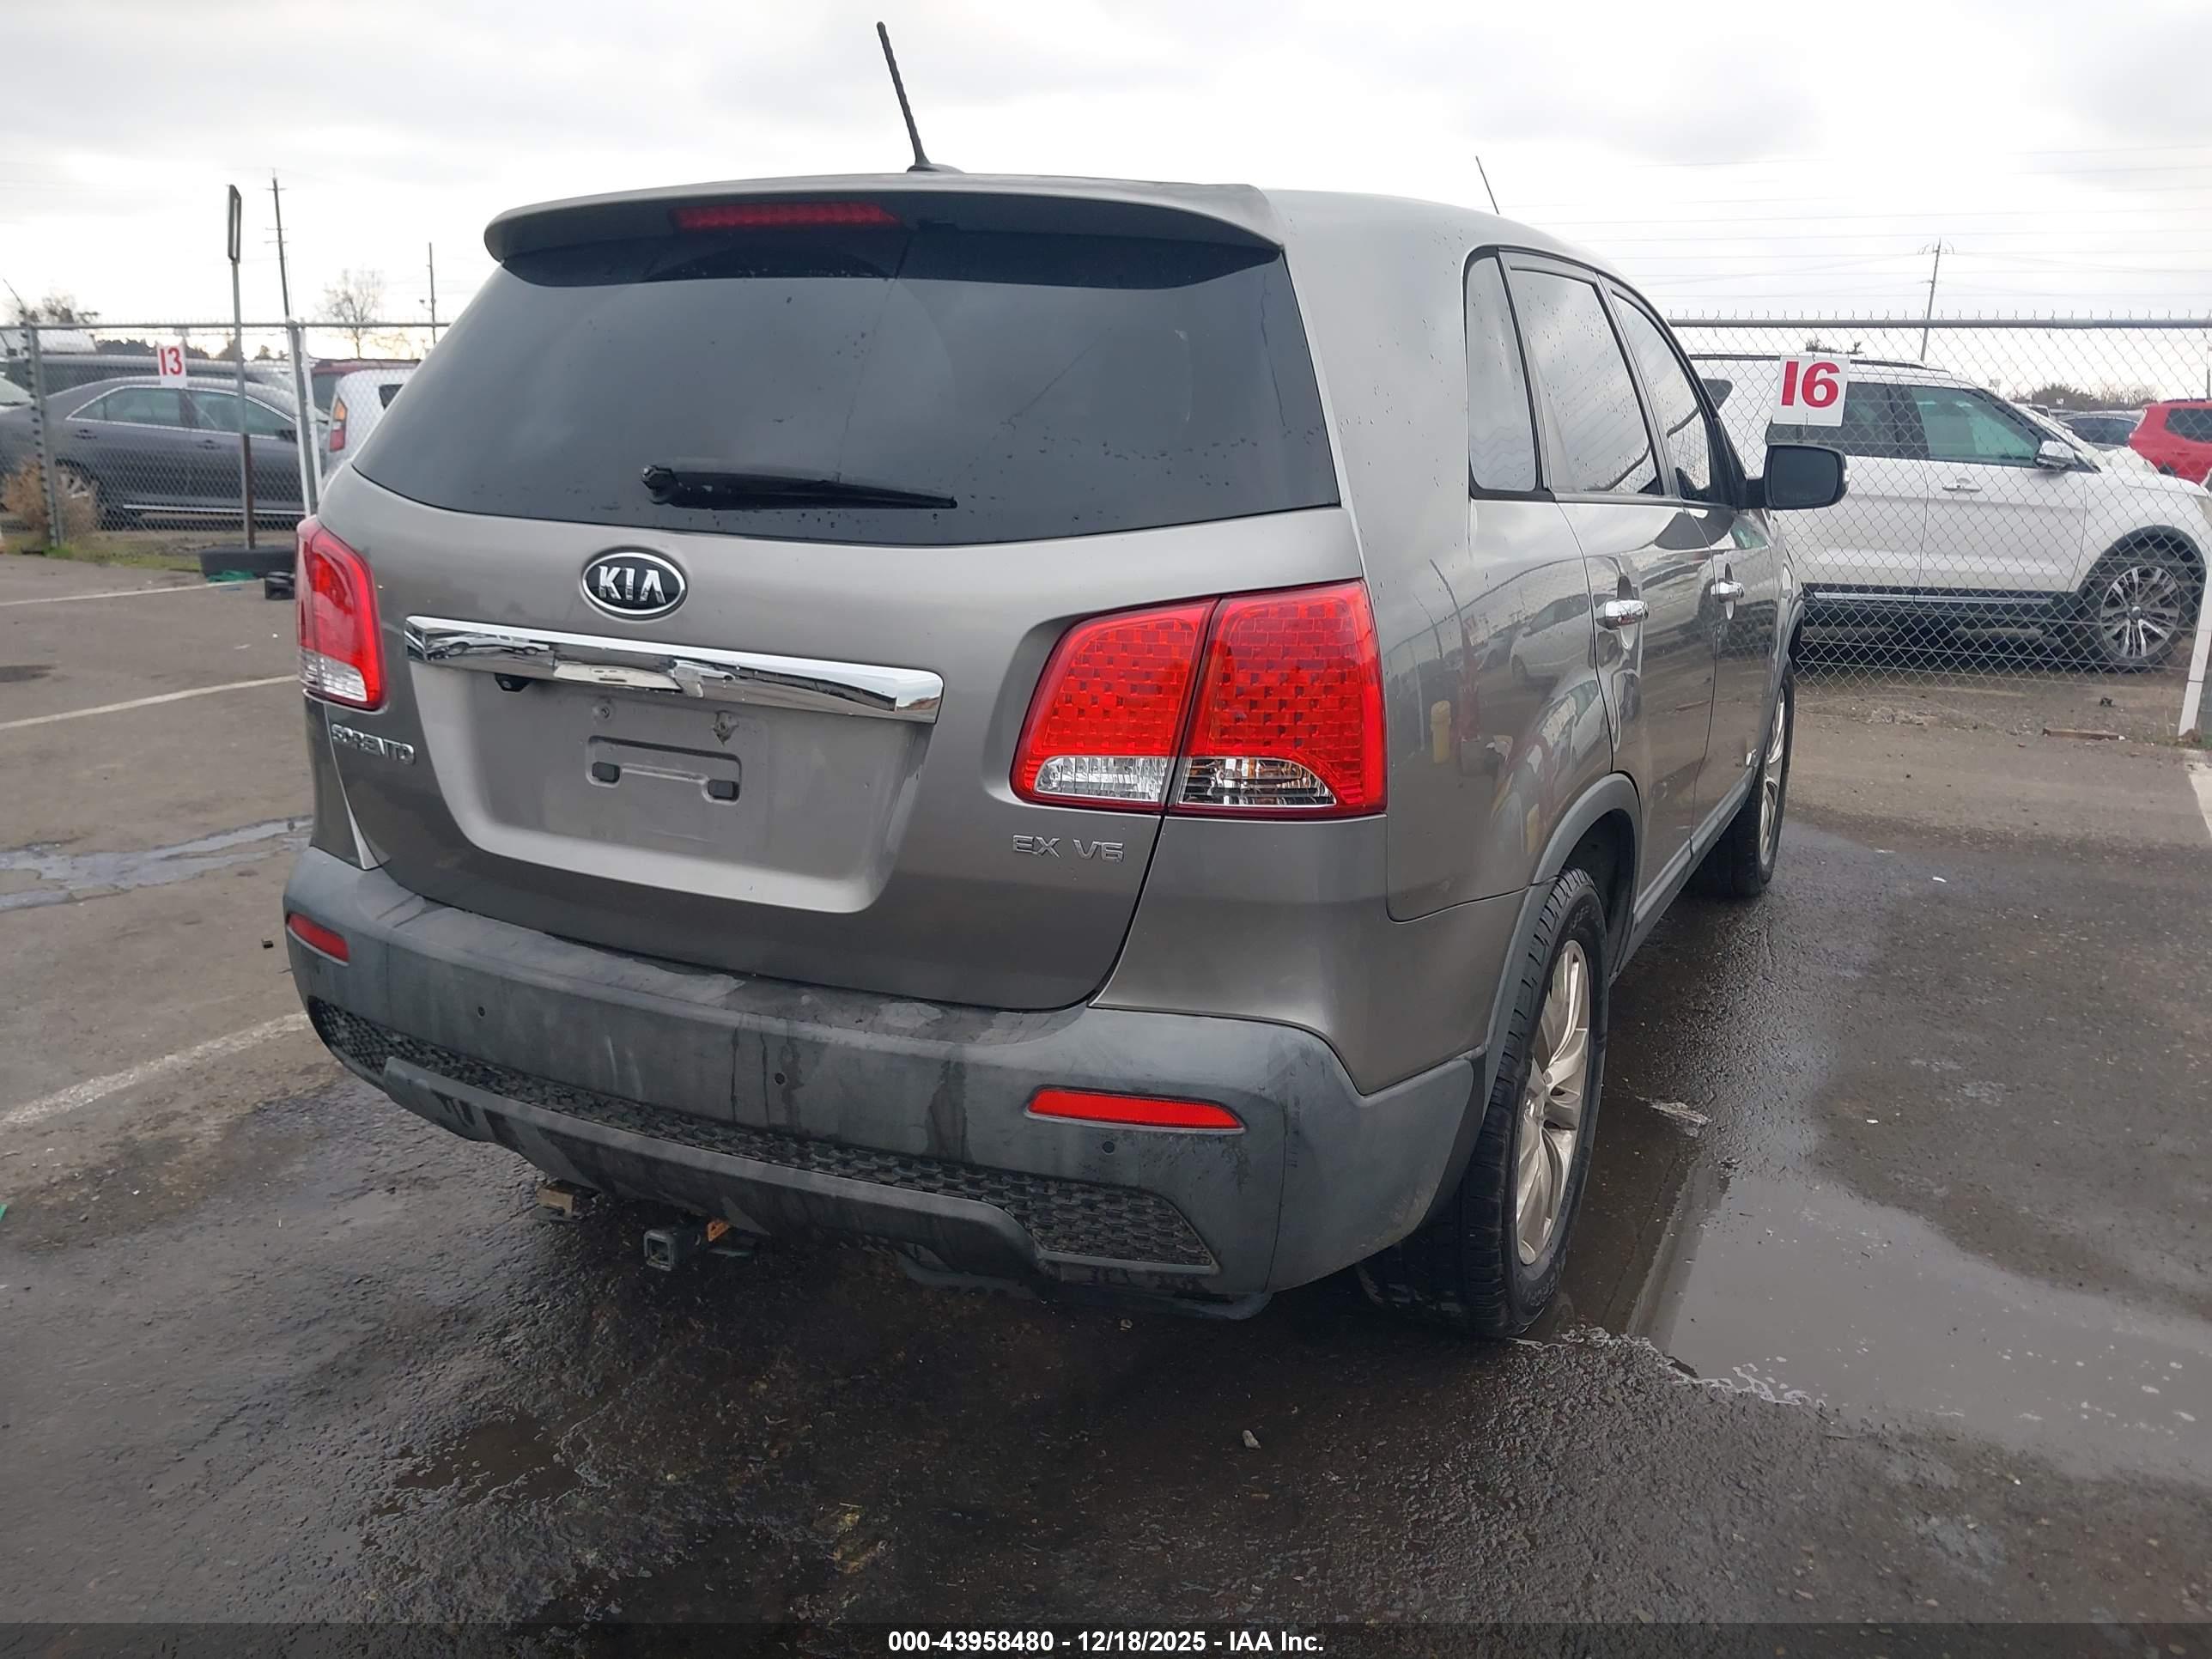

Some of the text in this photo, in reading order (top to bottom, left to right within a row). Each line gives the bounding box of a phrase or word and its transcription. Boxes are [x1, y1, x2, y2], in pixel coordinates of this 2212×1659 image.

[160, 347, 182, 375] 13
[1781, 361, 1840, 408] 16
[599, 566, 666, 604] KIA
[331, 723, 414, 764] SORENTO
[1012, 835, 1124, 862] EX V6
